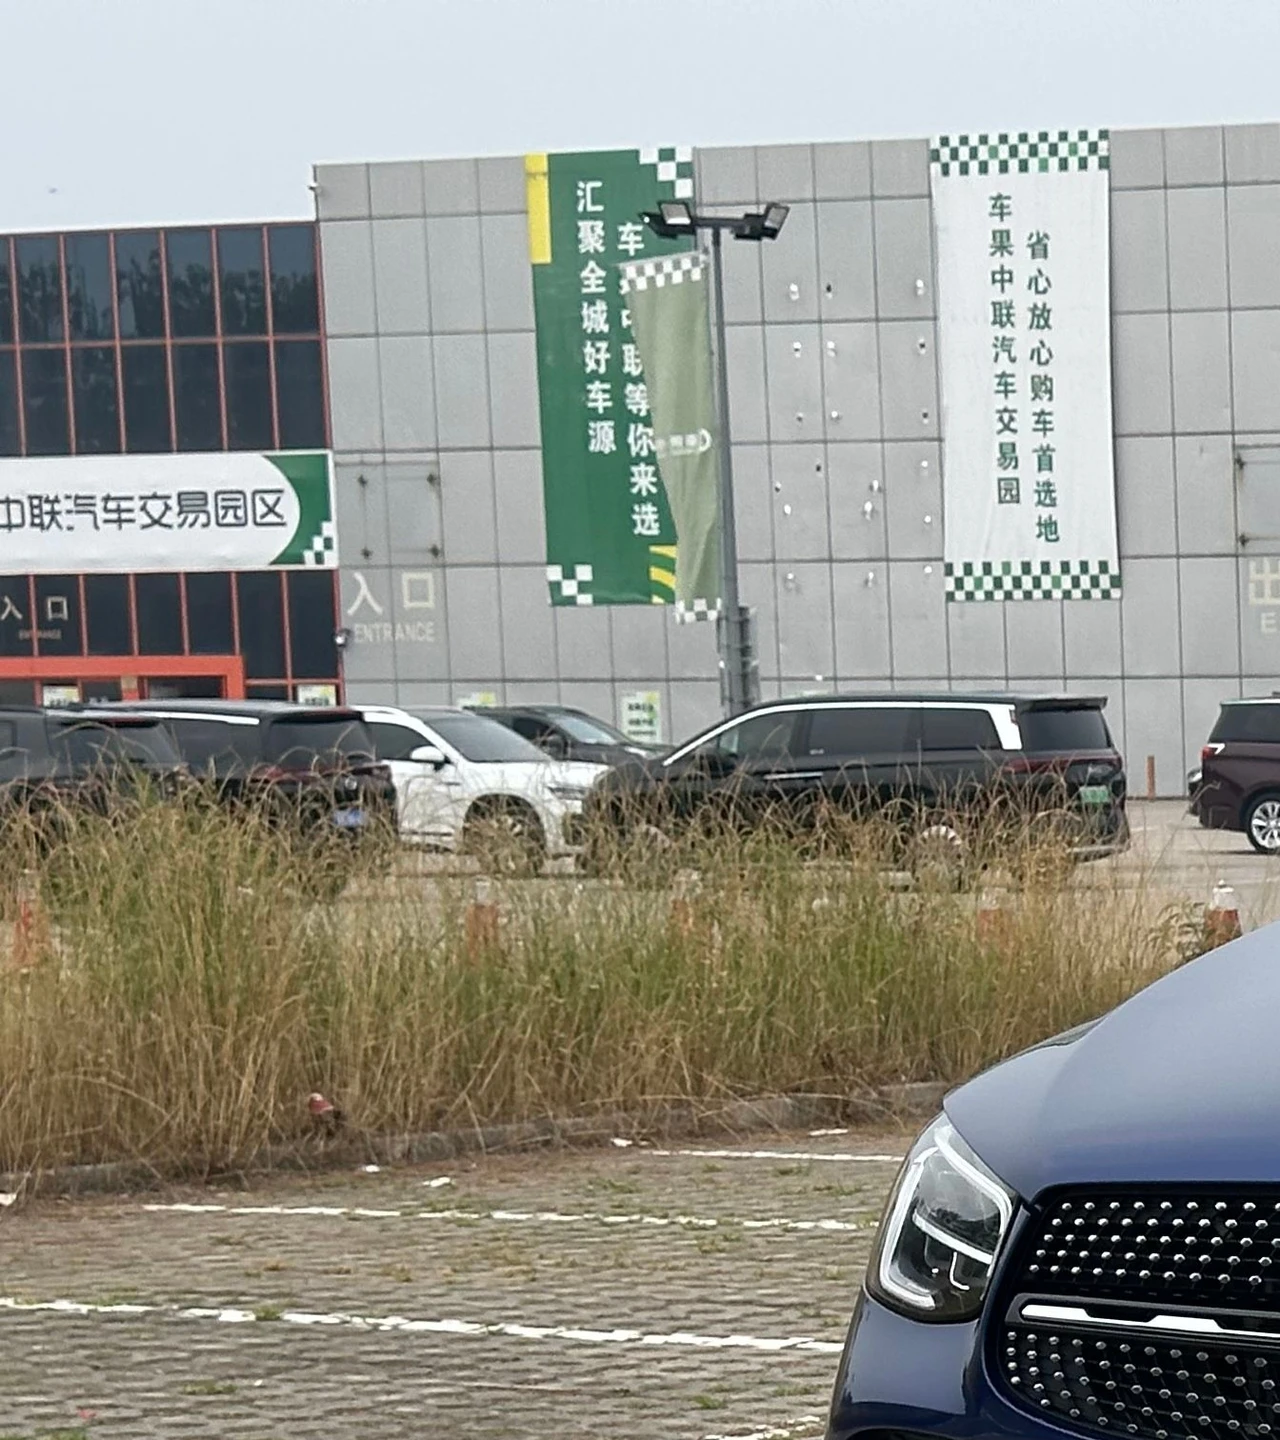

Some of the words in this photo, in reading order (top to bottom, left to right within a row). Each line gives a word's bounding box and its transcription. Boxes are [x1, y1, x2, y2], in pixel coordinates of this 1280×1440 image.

[577, 181, 617, 455] 汇聚全城好车源
[617, 221, 661, 536] 车联等你来选
[988, 192, 1021, 505] 车果中联汽车交易园
[1026, 230, 1060, 544] 省心放心购车首选地
[346, 571, 436, 617] 入口
[354, 621, 435, 643] ENTRANCE
